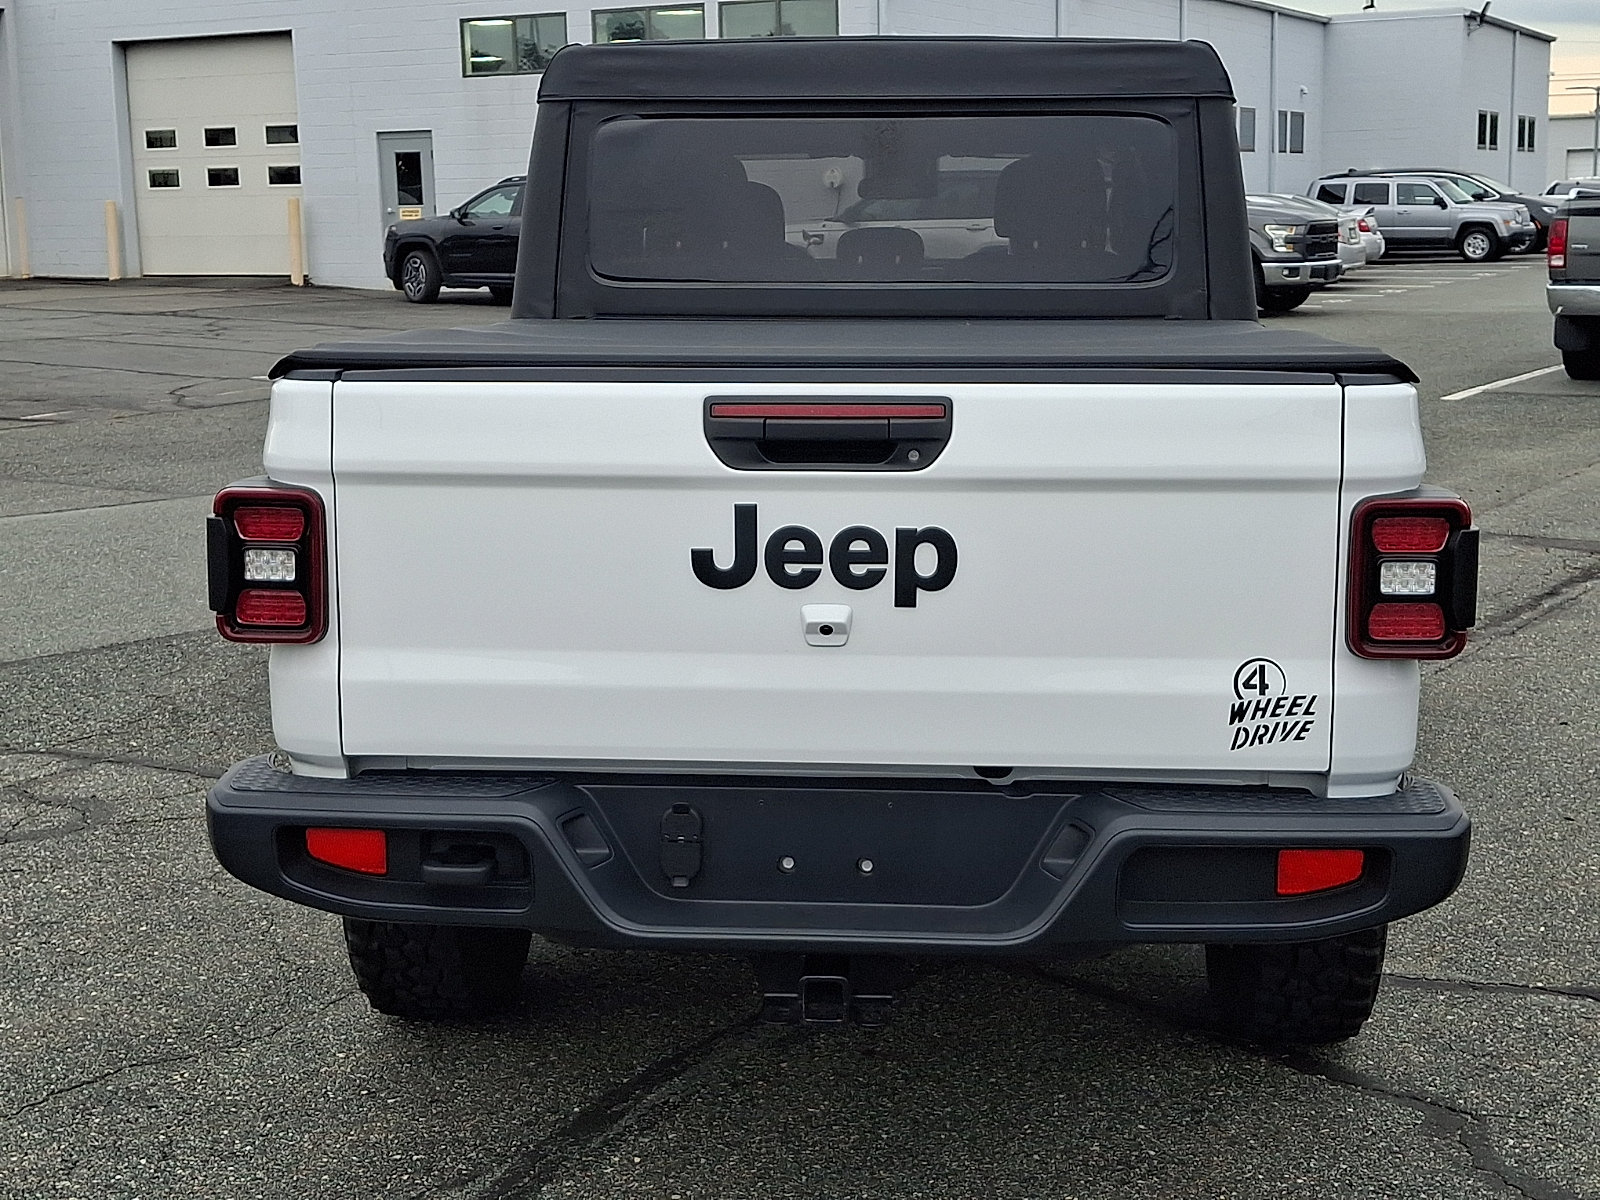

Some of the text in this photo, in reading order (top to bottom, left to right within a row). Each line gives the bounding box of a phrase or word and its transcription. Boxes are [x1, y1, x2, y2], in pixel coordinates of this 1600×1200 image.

[691, 503, 958, 608] Jeep
[1242, 664, 1269, 696] 4
[1229, 695, 1318, 726] WHEEL
[1230, 720, 1315, 751] DRIVE
